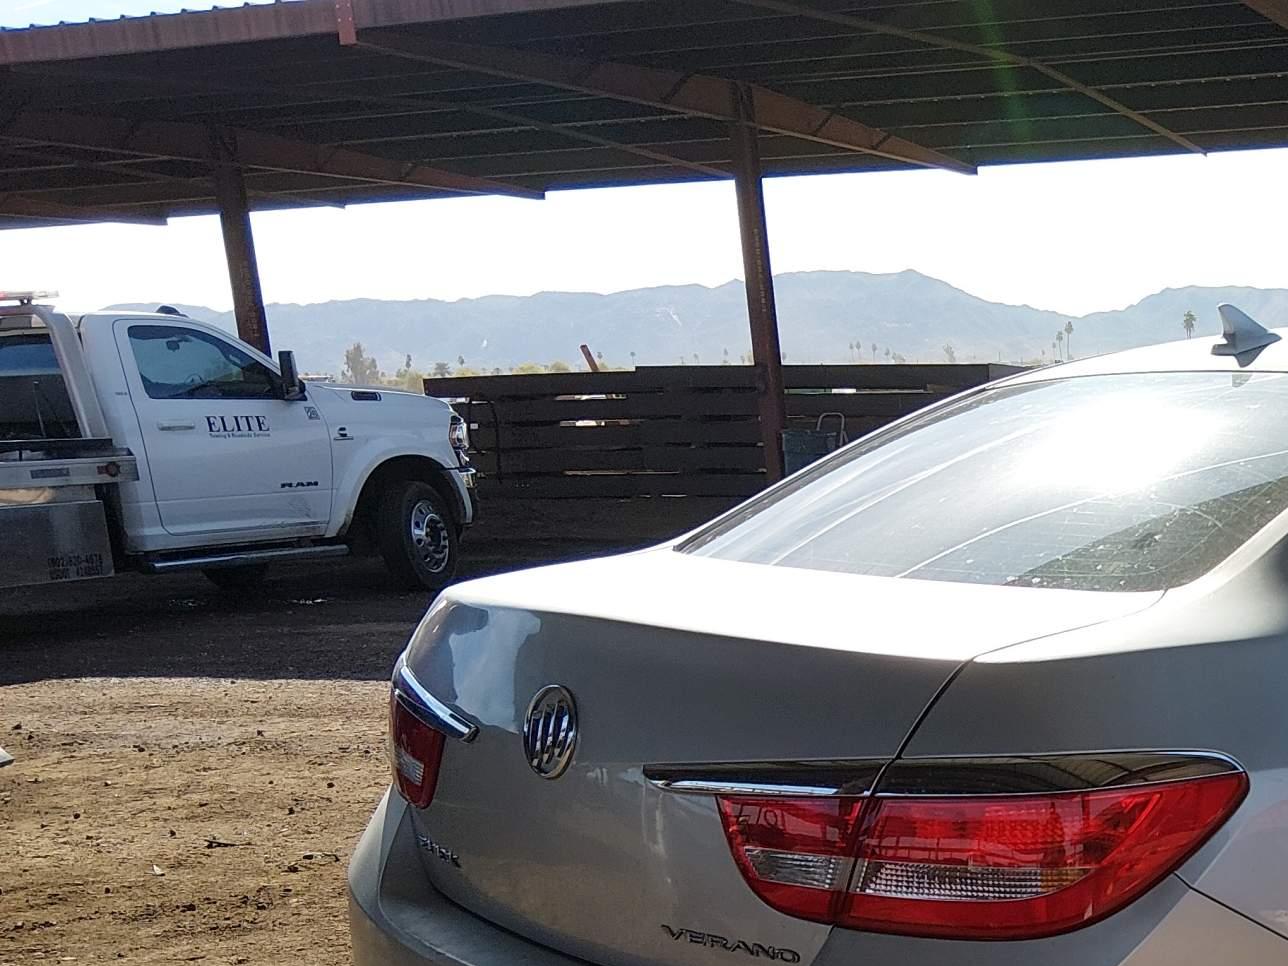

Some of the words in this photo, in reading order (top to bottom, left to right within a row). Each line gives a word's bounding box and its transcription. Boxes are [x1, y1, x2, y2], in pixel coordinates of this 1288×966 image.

[204, 415, 270, 433] ELITE
[280, 481, 319, 489] RAM
[660, 924, 801, 964] VERANO
